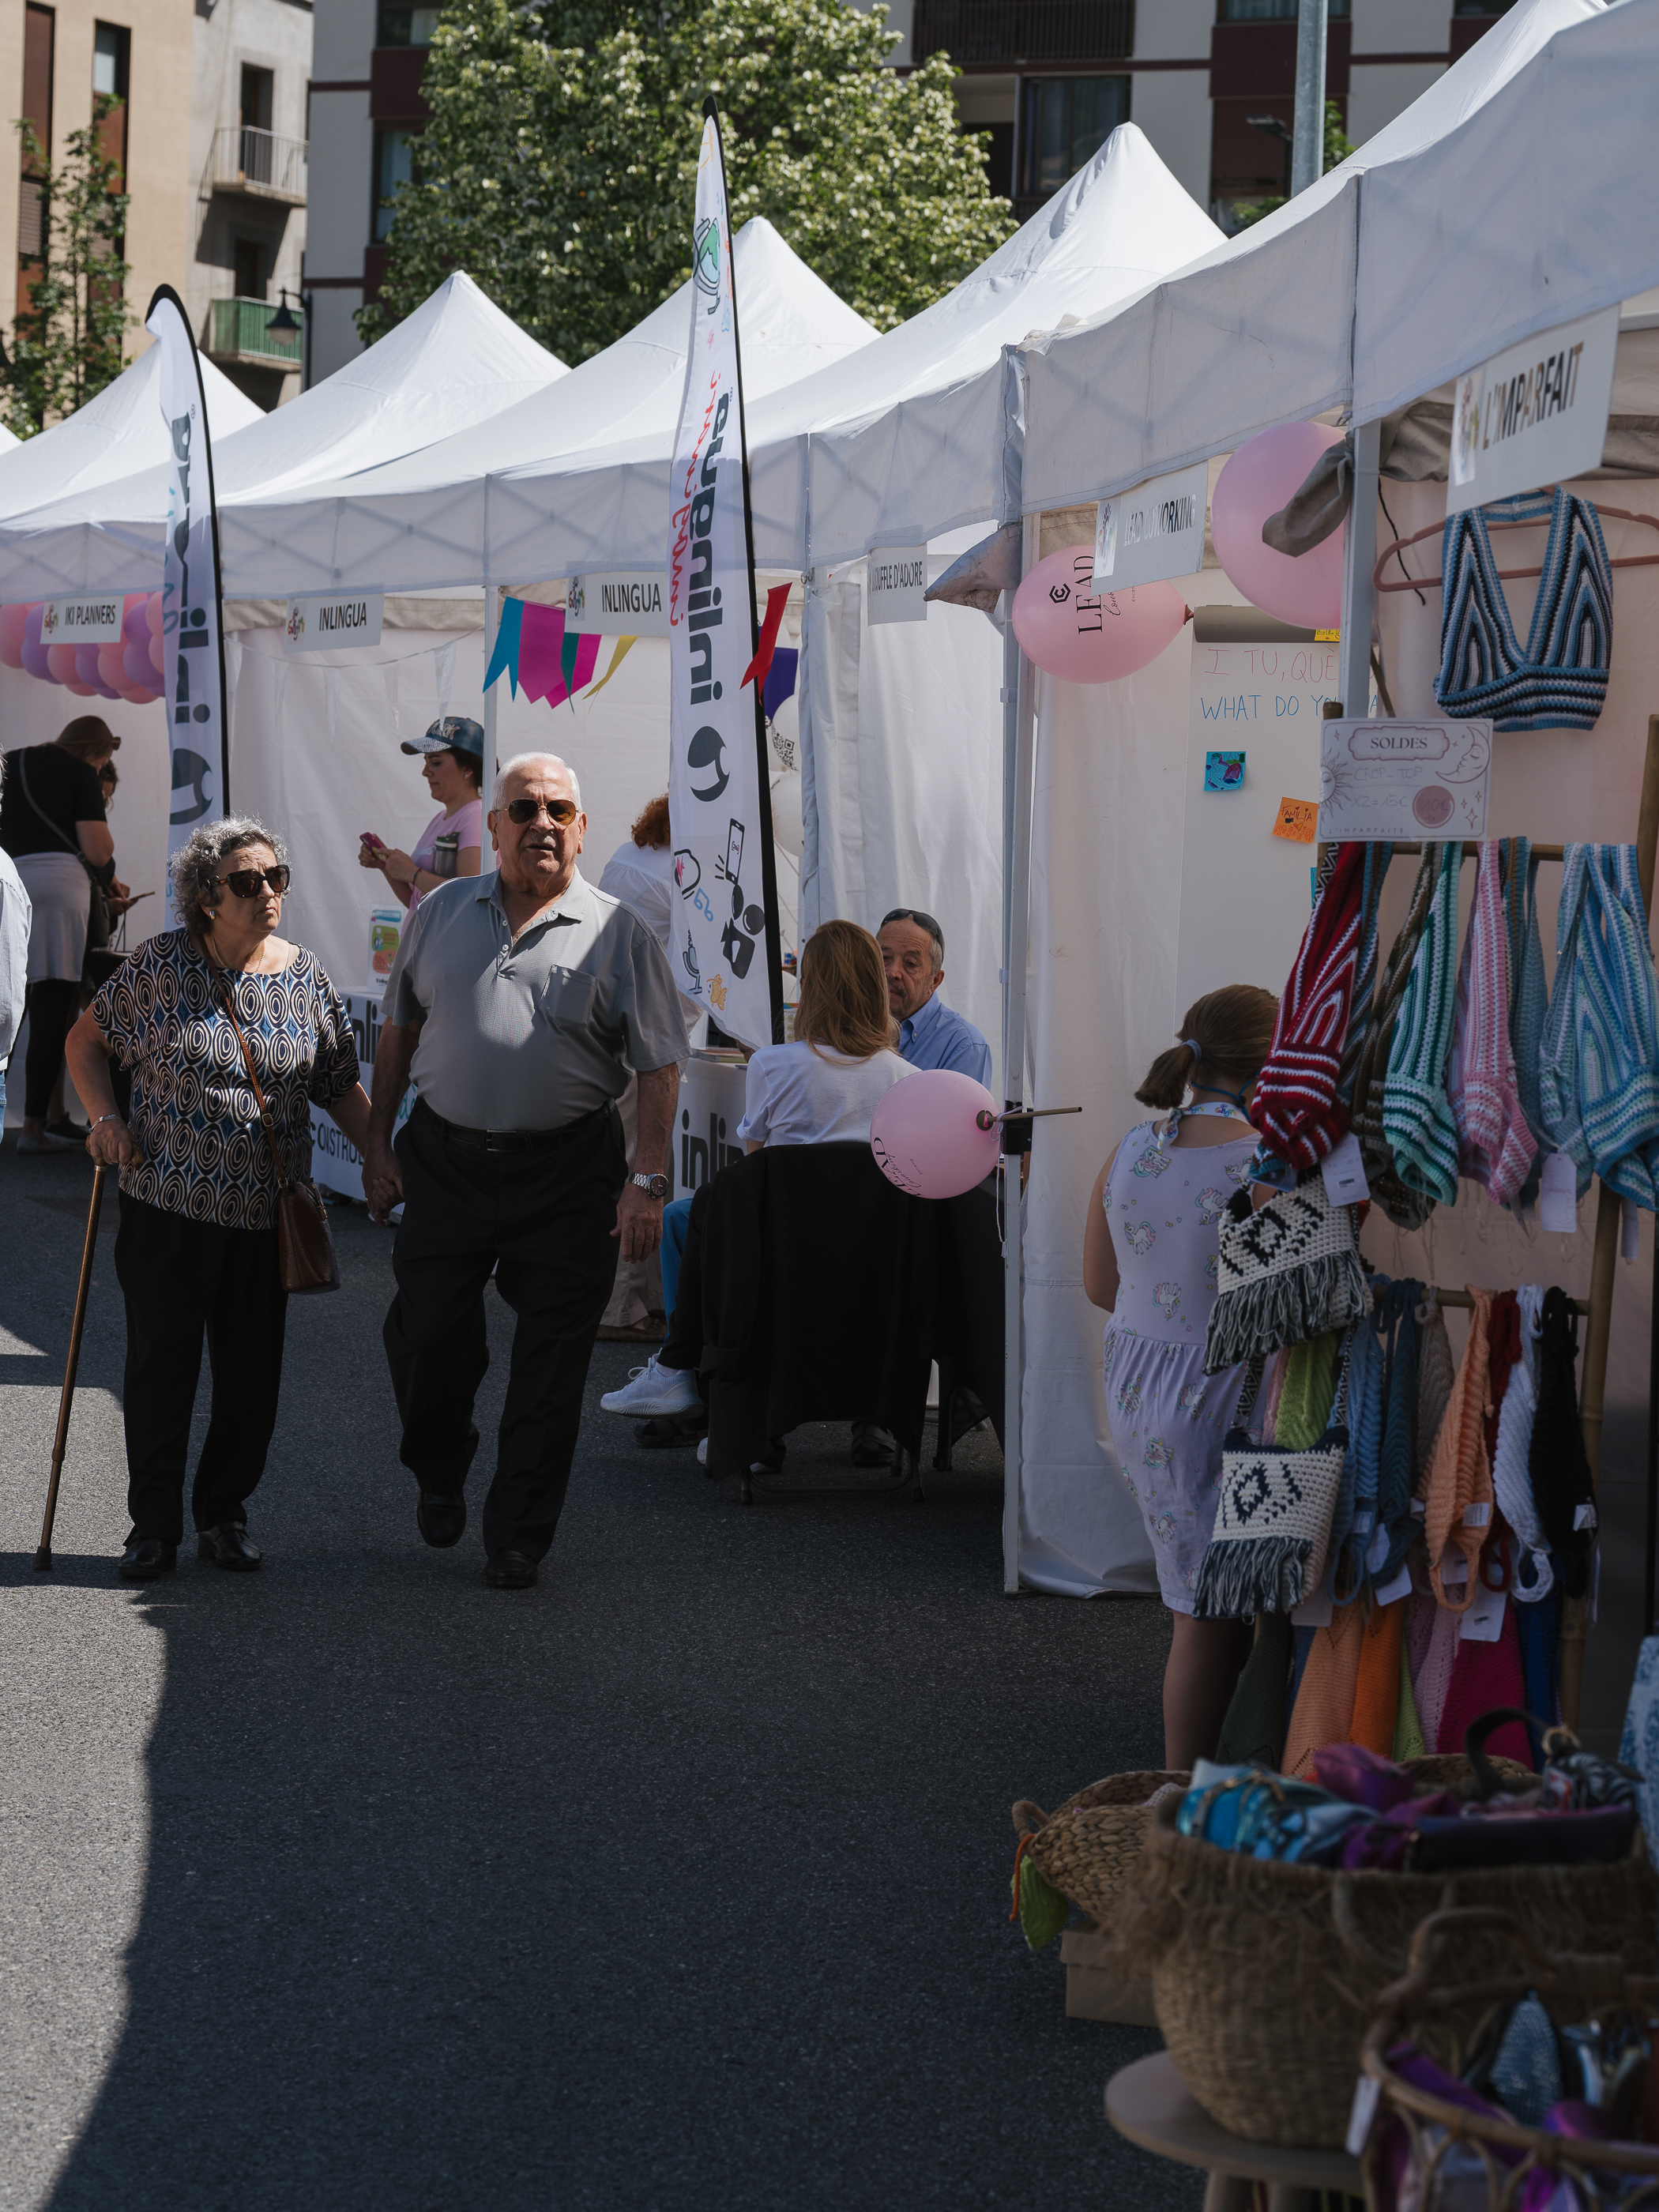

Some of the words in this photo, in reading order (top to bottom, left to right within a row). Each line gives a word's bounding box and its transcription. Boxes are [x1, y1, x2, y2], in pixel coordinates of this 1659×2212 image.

[1483, 341, 1584, 450] L'IMPARFAIT
[1123, 510, 1144, 547] LEAD
[1144, 494, 1196, 541] COWORKING
[893, 561, 923, 589] D'ADORE
[601, 583, 662, 613] INLINGUA
[65, 605, 74, 626] IKI
[76, 604, 116, 625] PLANNERS
[319, 602, 367, 631] INLINGUA
[1201, 694, 1262, 720] WHAT
[1276, 695, 1300, 717] DO
[1370, 737, 1428, 750] SOLDES
